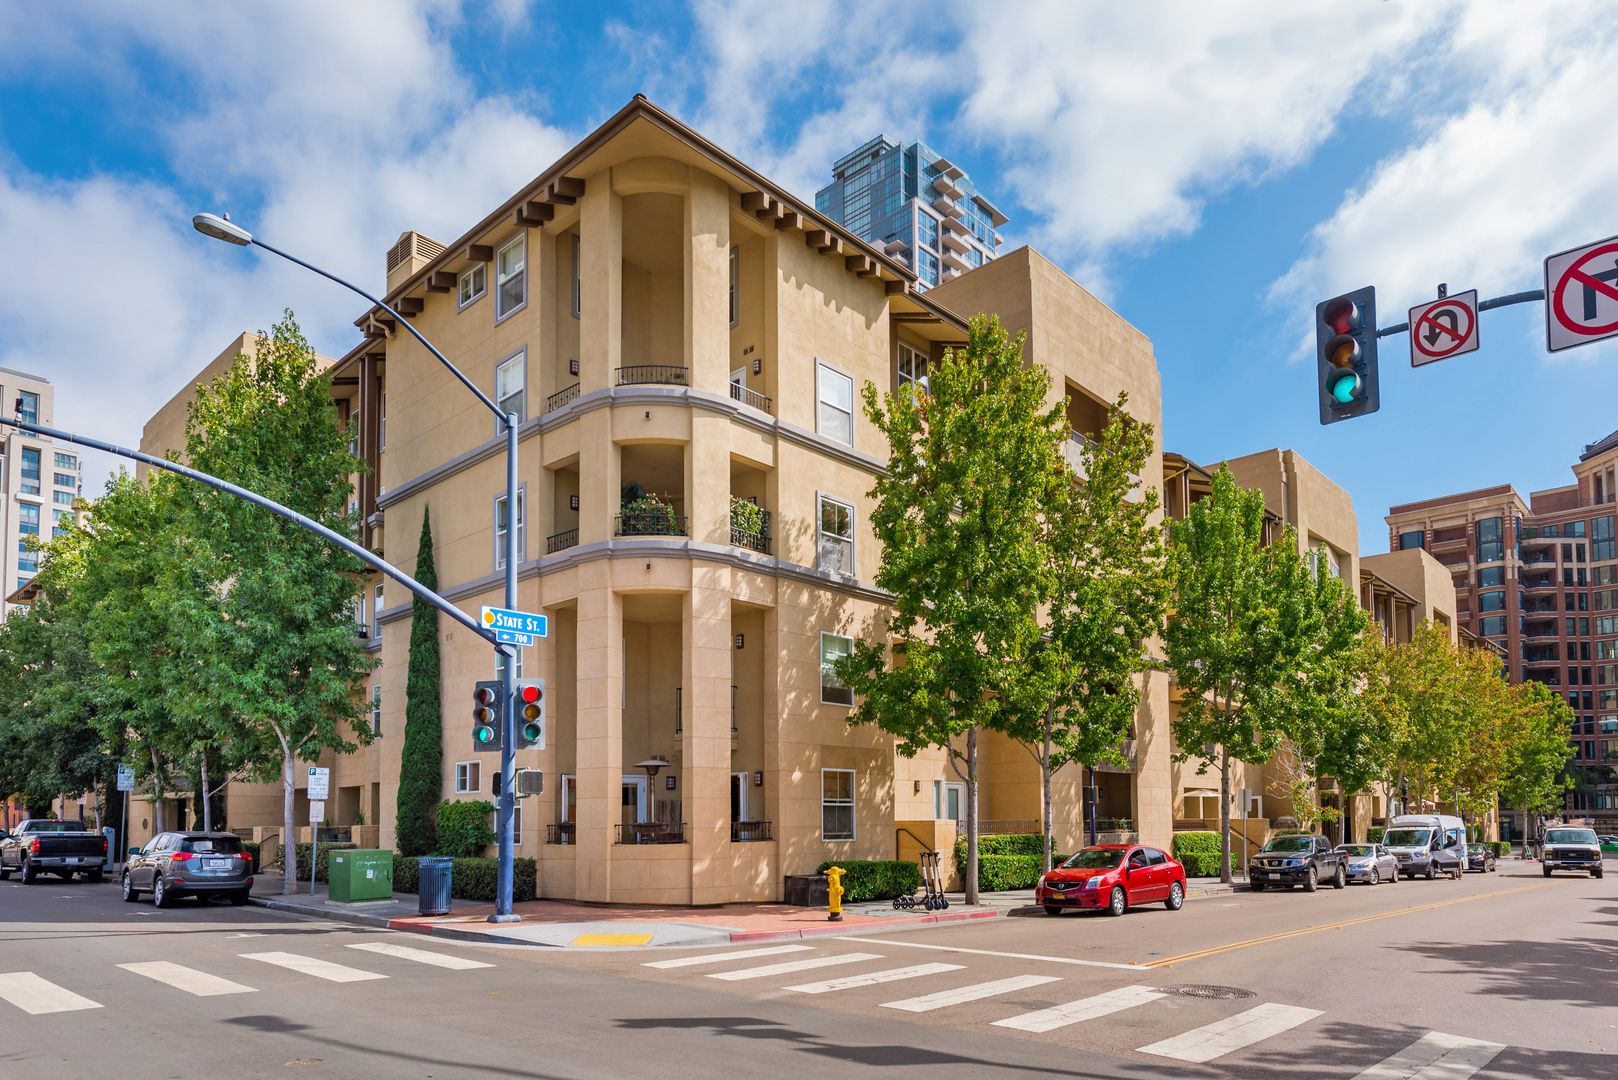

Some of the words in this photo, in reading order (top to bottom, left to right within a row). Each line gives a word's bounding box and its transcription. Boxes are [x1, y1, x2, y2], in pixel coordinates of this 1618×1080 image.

[496, 613, 523, 629] STATE
[526, 617, 540, 632] ST.
[514, 633, 528, 644] 700
